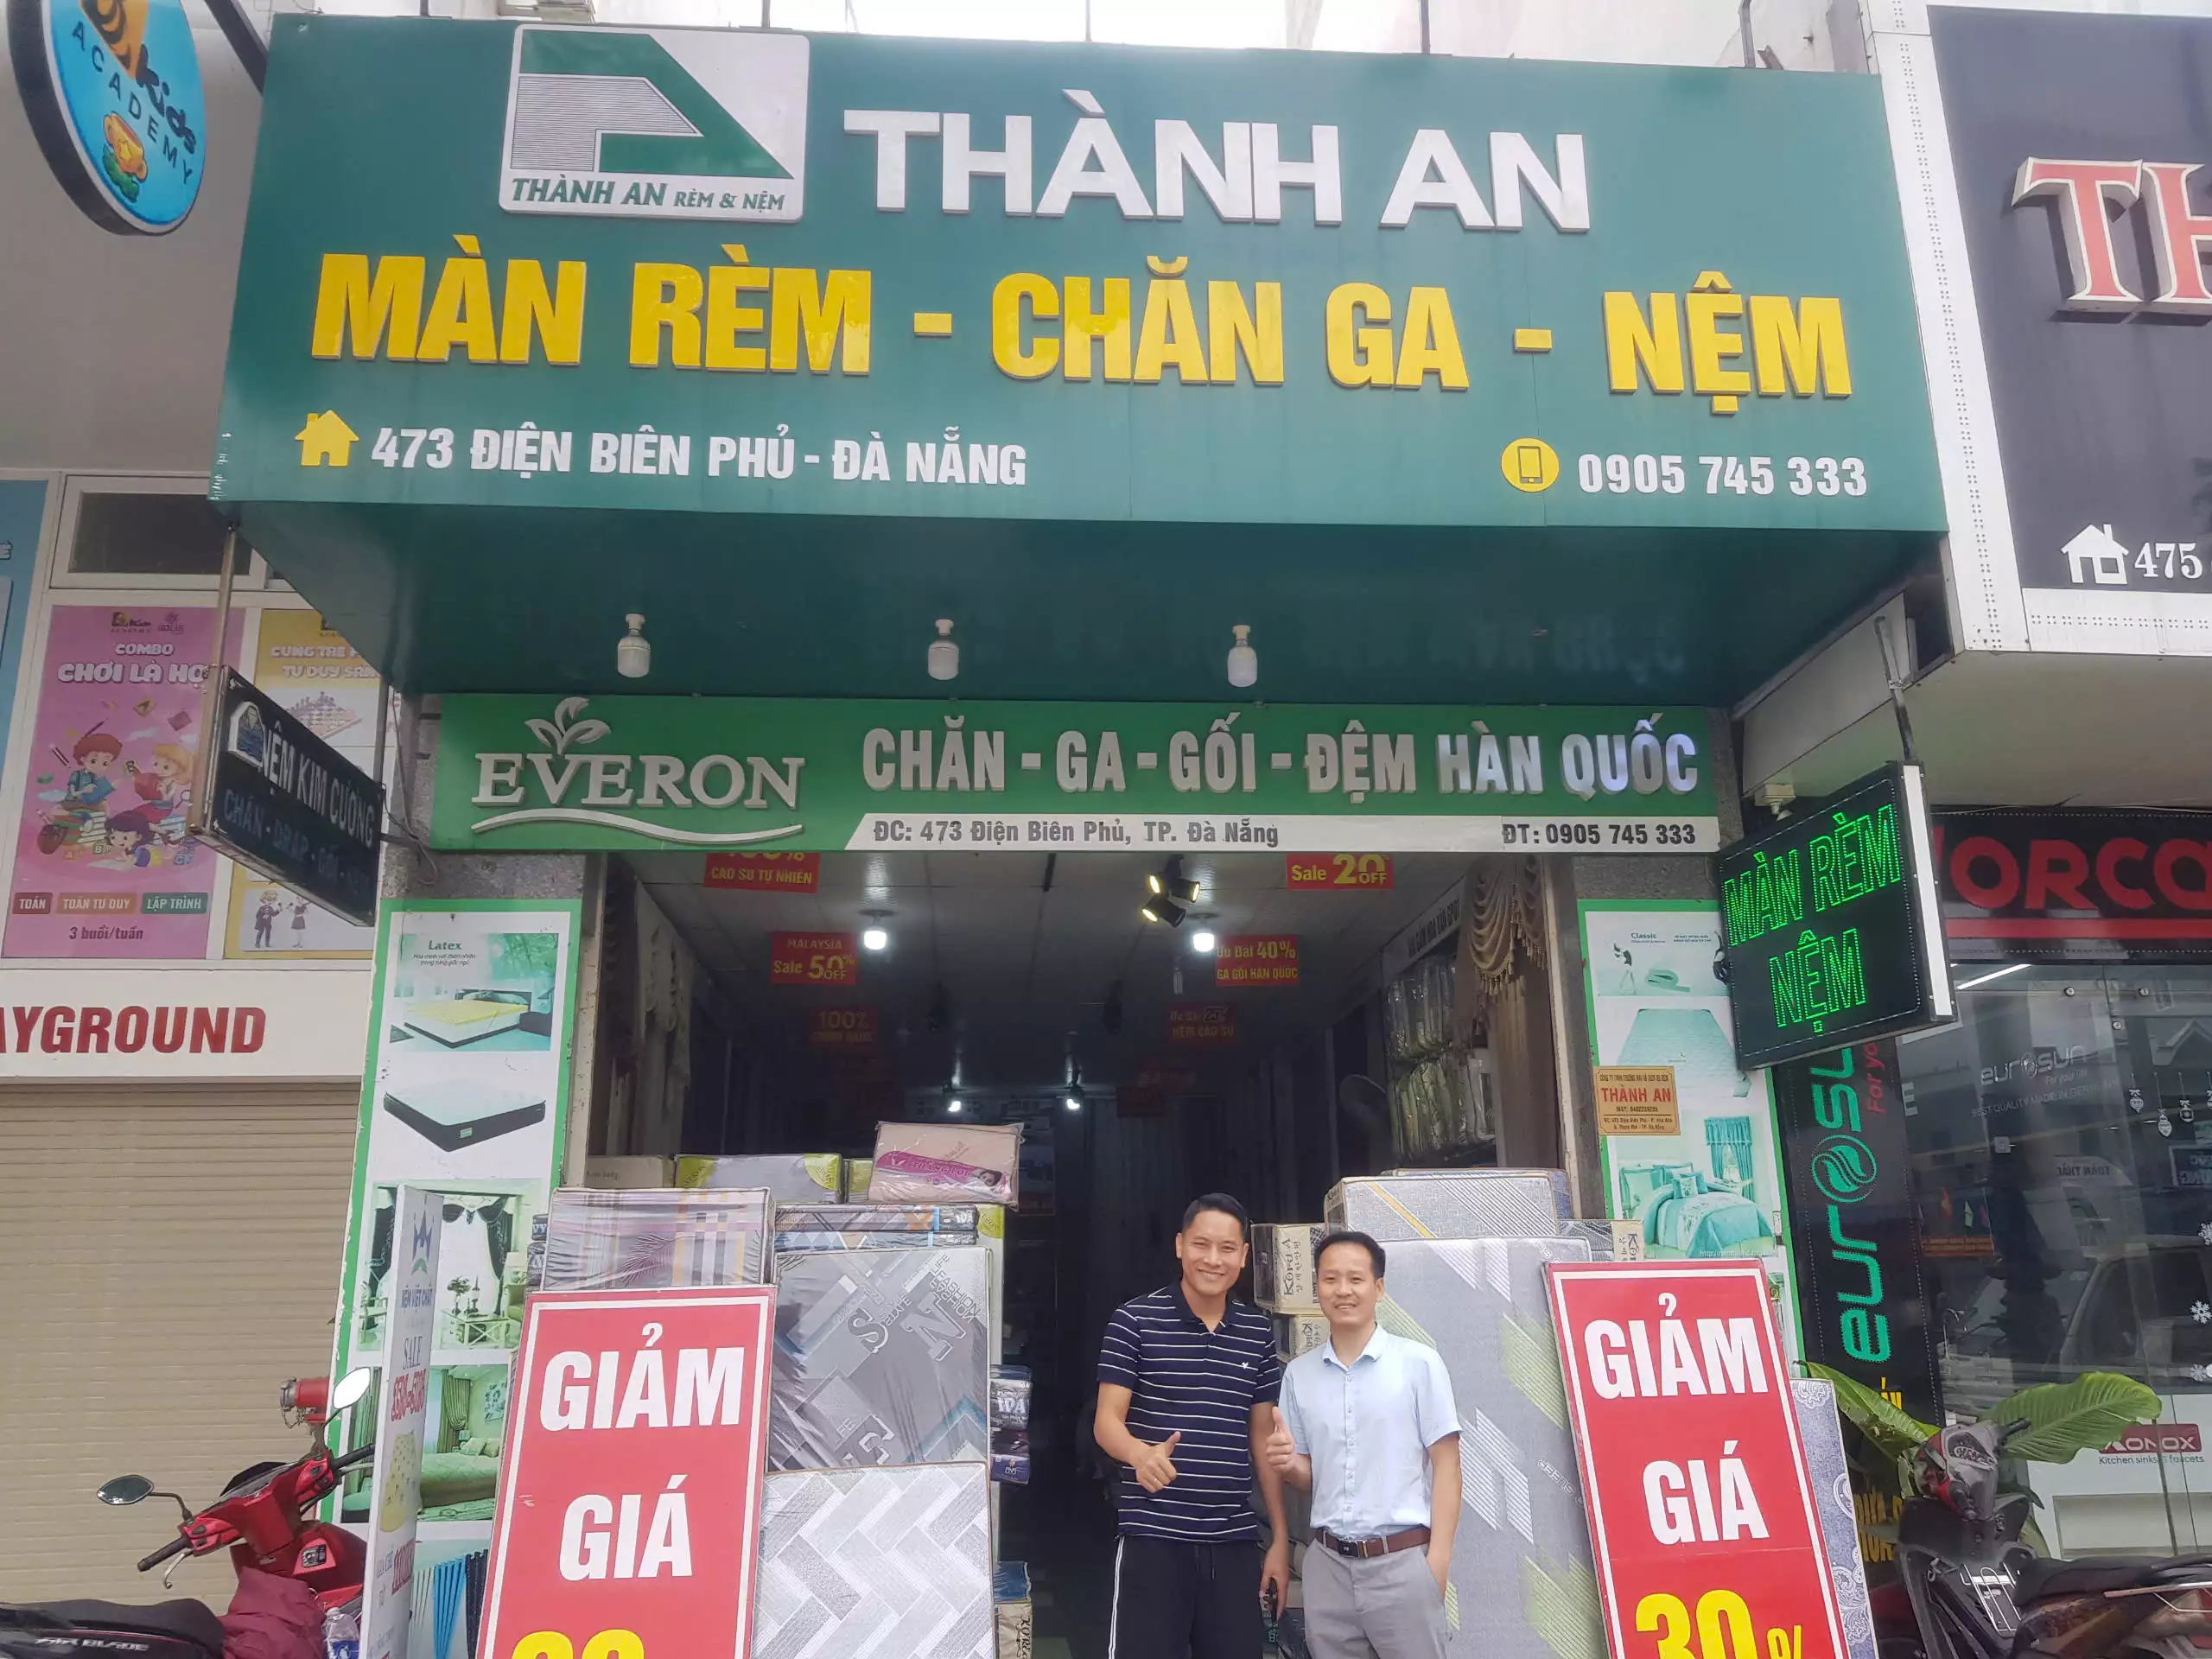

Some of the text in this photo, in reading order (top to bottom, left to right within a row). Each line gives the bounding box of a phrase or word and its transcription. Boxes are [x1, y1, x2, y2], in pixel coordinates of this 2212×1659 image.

[72, 21, 193, 184] ACADEMY
[844, 89, 1590, 233] THÀNH AN
[512, 174, 785, 213] THÀNH AN RÈM & NỆM
[312, 235, 587, 365] MÀN
[629, 244, 871, 377] RÈM
[992, 256, 1285, 387] CHĂN
[1325, 283, 1471, 392] GA
[1603, 270, 1853, 415] NỆM
[372, 428, 454, 469] 473
[469, 421, 571, 479] ĐIỆN
[589, 424, 690, 477] BIÊN
[707, 423, 794, 480] PHỦ
[832, 432, 891, 483] ĐÀ
[906, 426, 1027, 486] NẴNG
[1579, 454, 1868, 498] 0905 745 333
[2134, 543, 2202, 579] 475
[115, 643, 175, 656] COMBO
[57, 659, 208, 689] CHƠI LÀ HỌ
[261, 721, 295, 795] NỆM
[297, 753, 327, 817] KIM
[864, 715, 1004, 791] CHĂN
[1056, 730, 1126, 793] GA
[1169, 711, 1256, 792] GỐI
[1306, 720, 1417, 804] ĐỆM
[1436, 720, 1543, 795] HÀN
[1560, 712, 1698, 801] QUỐC
[471, 753, 804, 810] EVERON
[873, 817, 1280, 849] ĐC: 473 Điện Biên Phủ, TP. Đà Nẵng
[1501, 823, 1696, 846] ĐT: 0905 745 333
[711, 867, 734, 880] CAO
[738, 868, 754, 880] SU
[1292, 865, 1327, 881] Sale
[1358, 872, 1388, 885] OFF
[1724, 804, 1902, 948] MÀN RÈM
[20, 897, 47, 909] TOÁN
[109, 898, 130, 910] DUY
[147, 896, 202, 912] LẬP TRÌNH
[69, 926, 77, 939] 3
[428, 940, 462, 950] Latex
[773, 959, 803, 974] Sale
[1769, 928, 1866, 1034] NỆM
[1600, 1084, 1672, 1103] THÀNH AN
[931, 1253, 950, 1275] LIFE
[402, 1336, 423, 1370] SALE
[1584, 1293, 1769, 1400] GIẢM
[539, 1321, 745, 1432] GIẢM
[2099, 1456, 2133, 1465] Kitchen
[2135, 1455, 2158, 1464] sinks
[1643, 1440, 1770, 1545] GIÁ
[558, 1474, 693, 1582] GIÁ
[82, 1639, 149, 1651] BLADE
